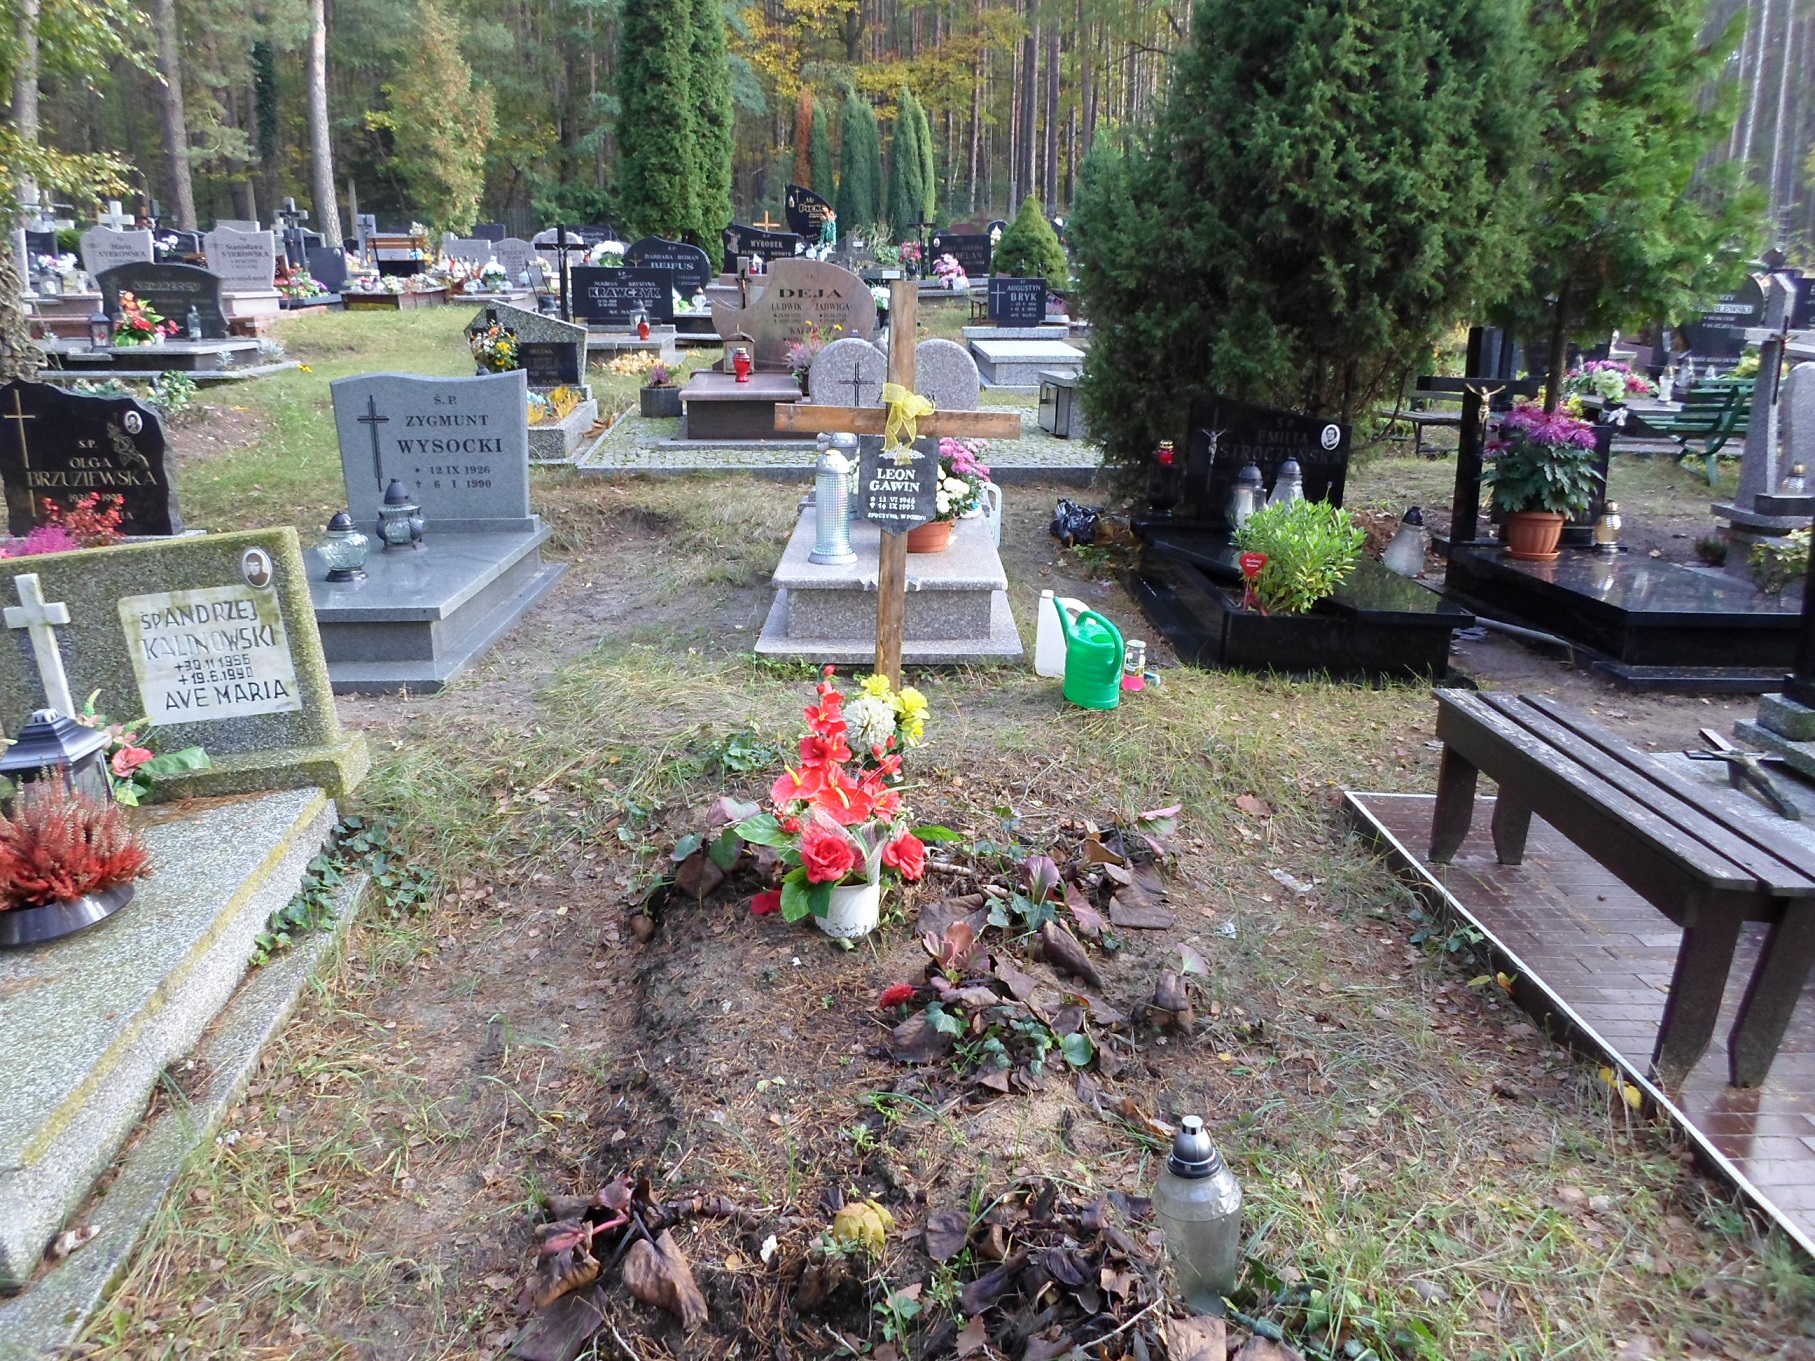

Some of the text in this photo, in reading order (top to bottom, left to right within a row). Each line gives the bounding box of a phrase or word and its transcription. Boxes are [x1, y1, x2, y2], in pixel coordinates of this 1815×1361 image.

[750, 239, 783, 248] WYROBEK
[588, 287, 662, 298] KRAWCZYK
[780, 288, 842, 298] DEJA
[1010, 292, 1037, 302] BRYK
[771, 302, 850, 311] LUDWIK JADWIGA
[406, 415, 489, 427] ZYGMUNT
[1257, 430, 1308, 445] EMILIA
[397, 438, 503, 454] WYSOCKI
[69, 457, 113, 469] OLGA
[430, 466, 490, 474] 12 IX 1926
[876, 468, 916, 480] LEON
[434, 480, 441, 488] 6
[466, 480, 492, 488] 1990
[869, 480, 920, 492] GAWIN
[164, 598, 258, 628] ANDRZEJ
[142, 625, 277, 660] KALINOWSKI
[166, 679, 290, 710] AVE MARIA
